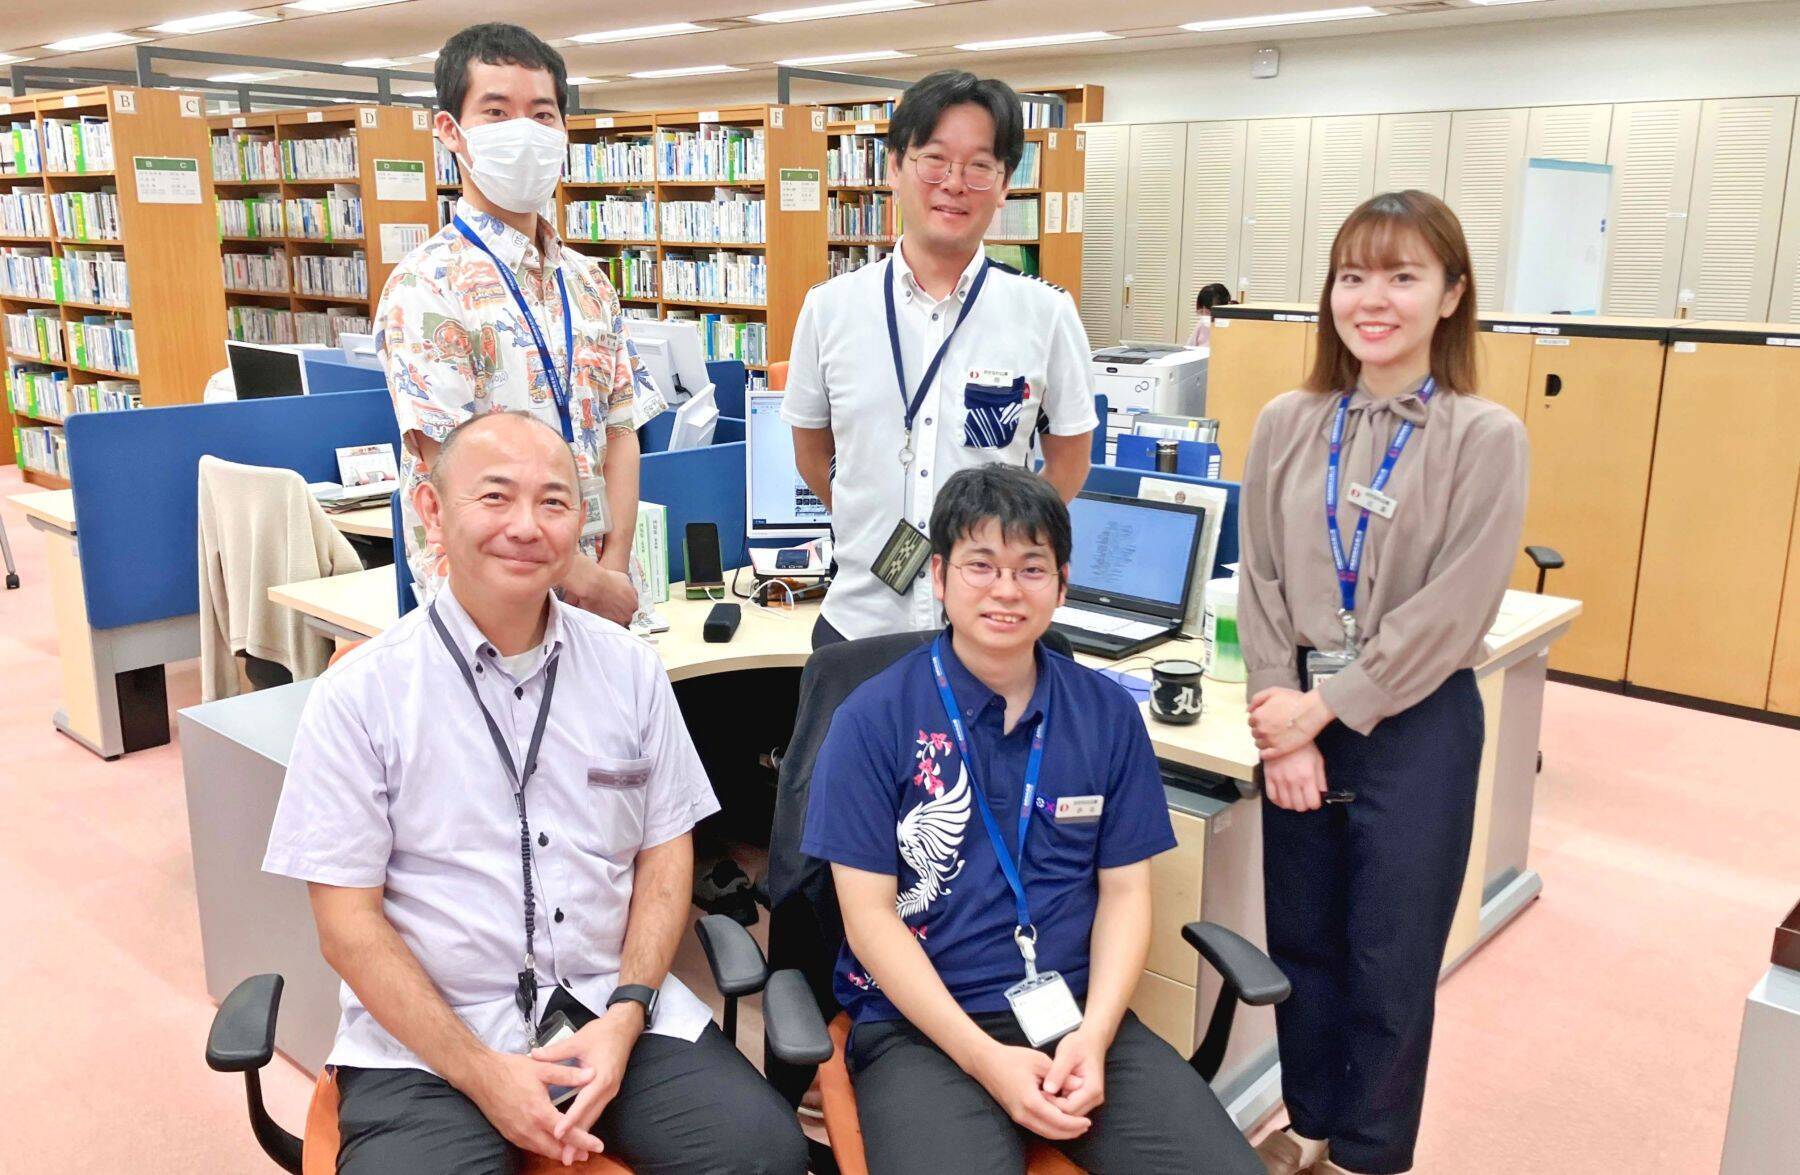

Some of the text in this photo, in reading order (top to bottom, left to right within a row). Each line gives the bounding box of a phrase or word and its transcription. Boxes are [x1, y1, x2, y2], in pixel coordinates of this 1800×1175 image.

[120, 95, 131, 107] B
[186, 100, 197, 113] C
[365, 112, 374, 124] D
[417, 114, 425, 126] E
[774, 112, 780, 123] F
[814, 115, 822, 127] G
[145, 160, 153, 168] B
[179, 161, 188, 169] C
